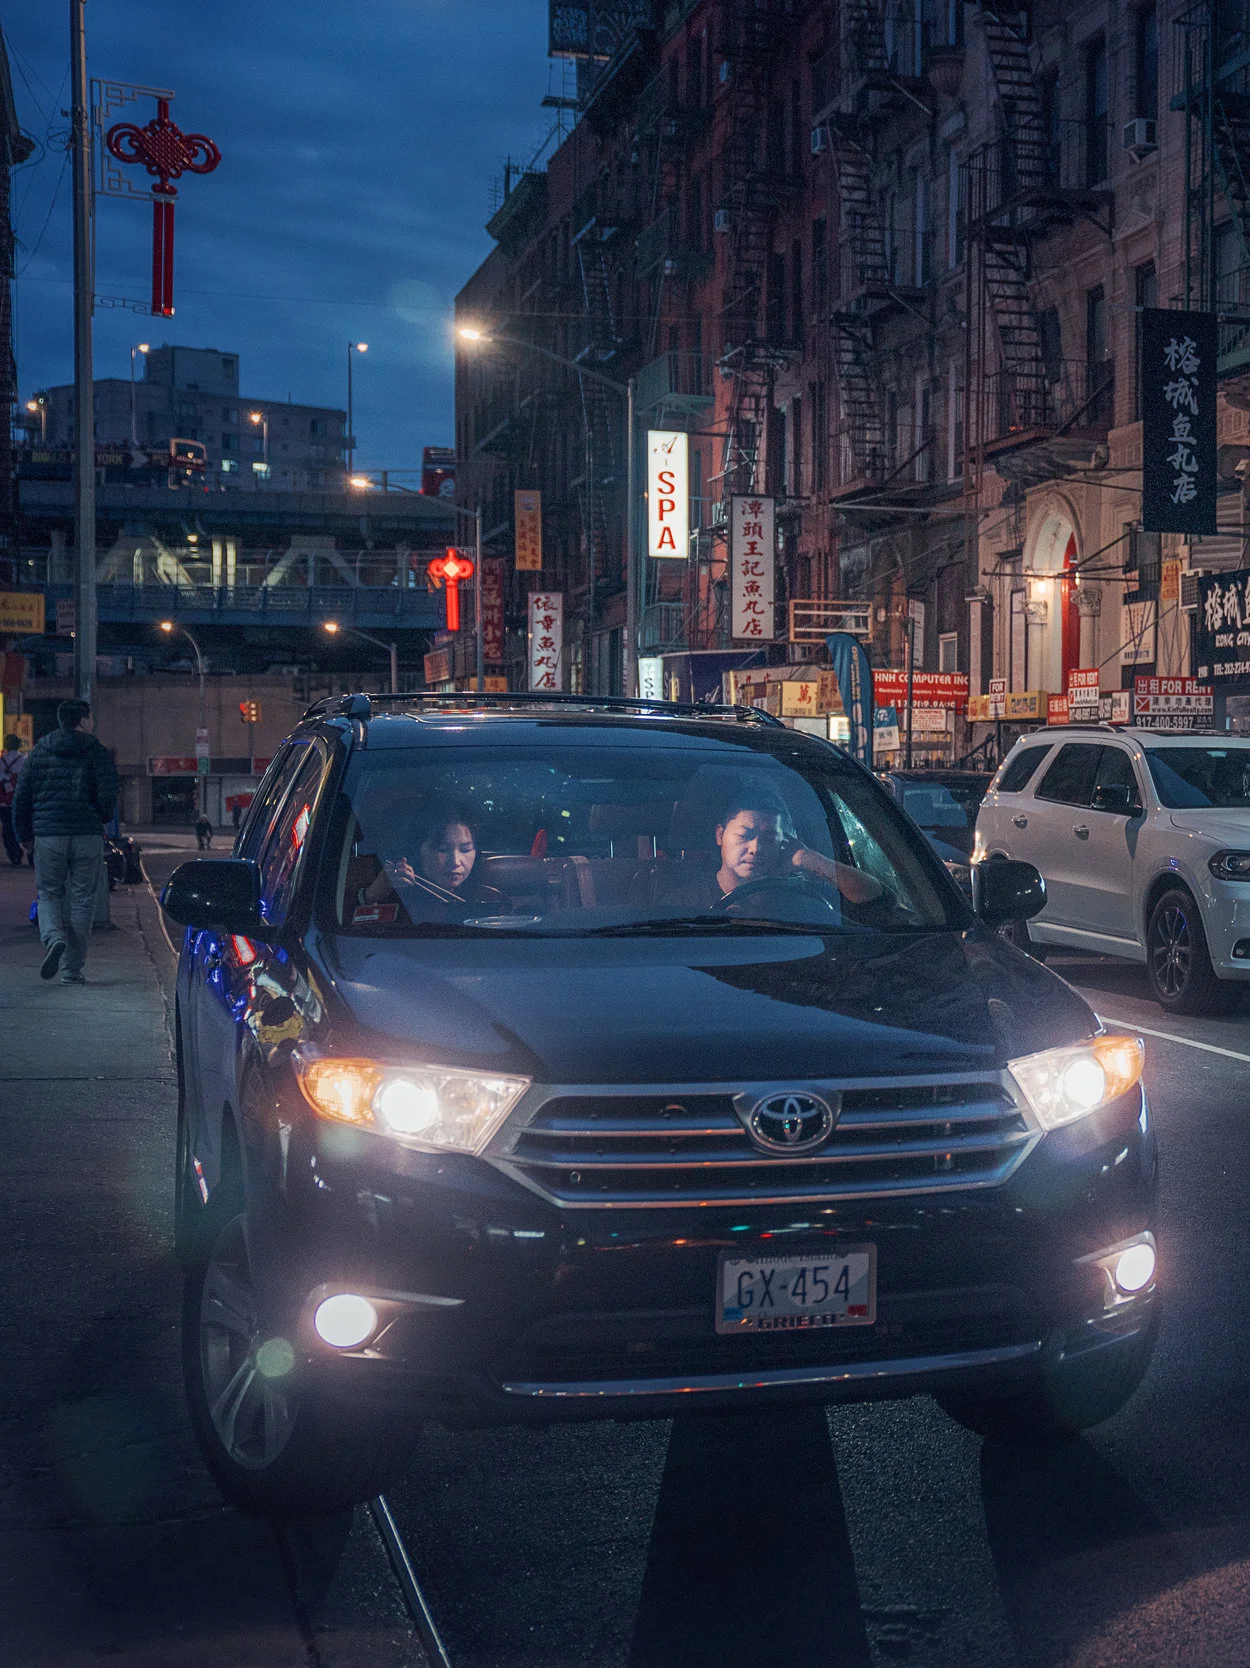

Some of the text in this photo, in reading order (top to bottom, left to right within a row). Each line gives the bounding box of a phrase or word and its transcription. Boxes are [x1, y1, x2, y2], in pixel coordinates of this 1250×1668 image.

[97, 453, 122, 465] YORK
[657, 471, 677, 550] SPA
[875, 673, 895, 683] HNH
[954, 676, 969, 685] INC
[991, 682, 1003, 691] FOR
[1138, 680, 1159, 694] 出租
[1161, 680, 1182, 694] FOR
[990, 693, 1004, 703] RENT
[737, 1264, 850, 1309] GX-454
